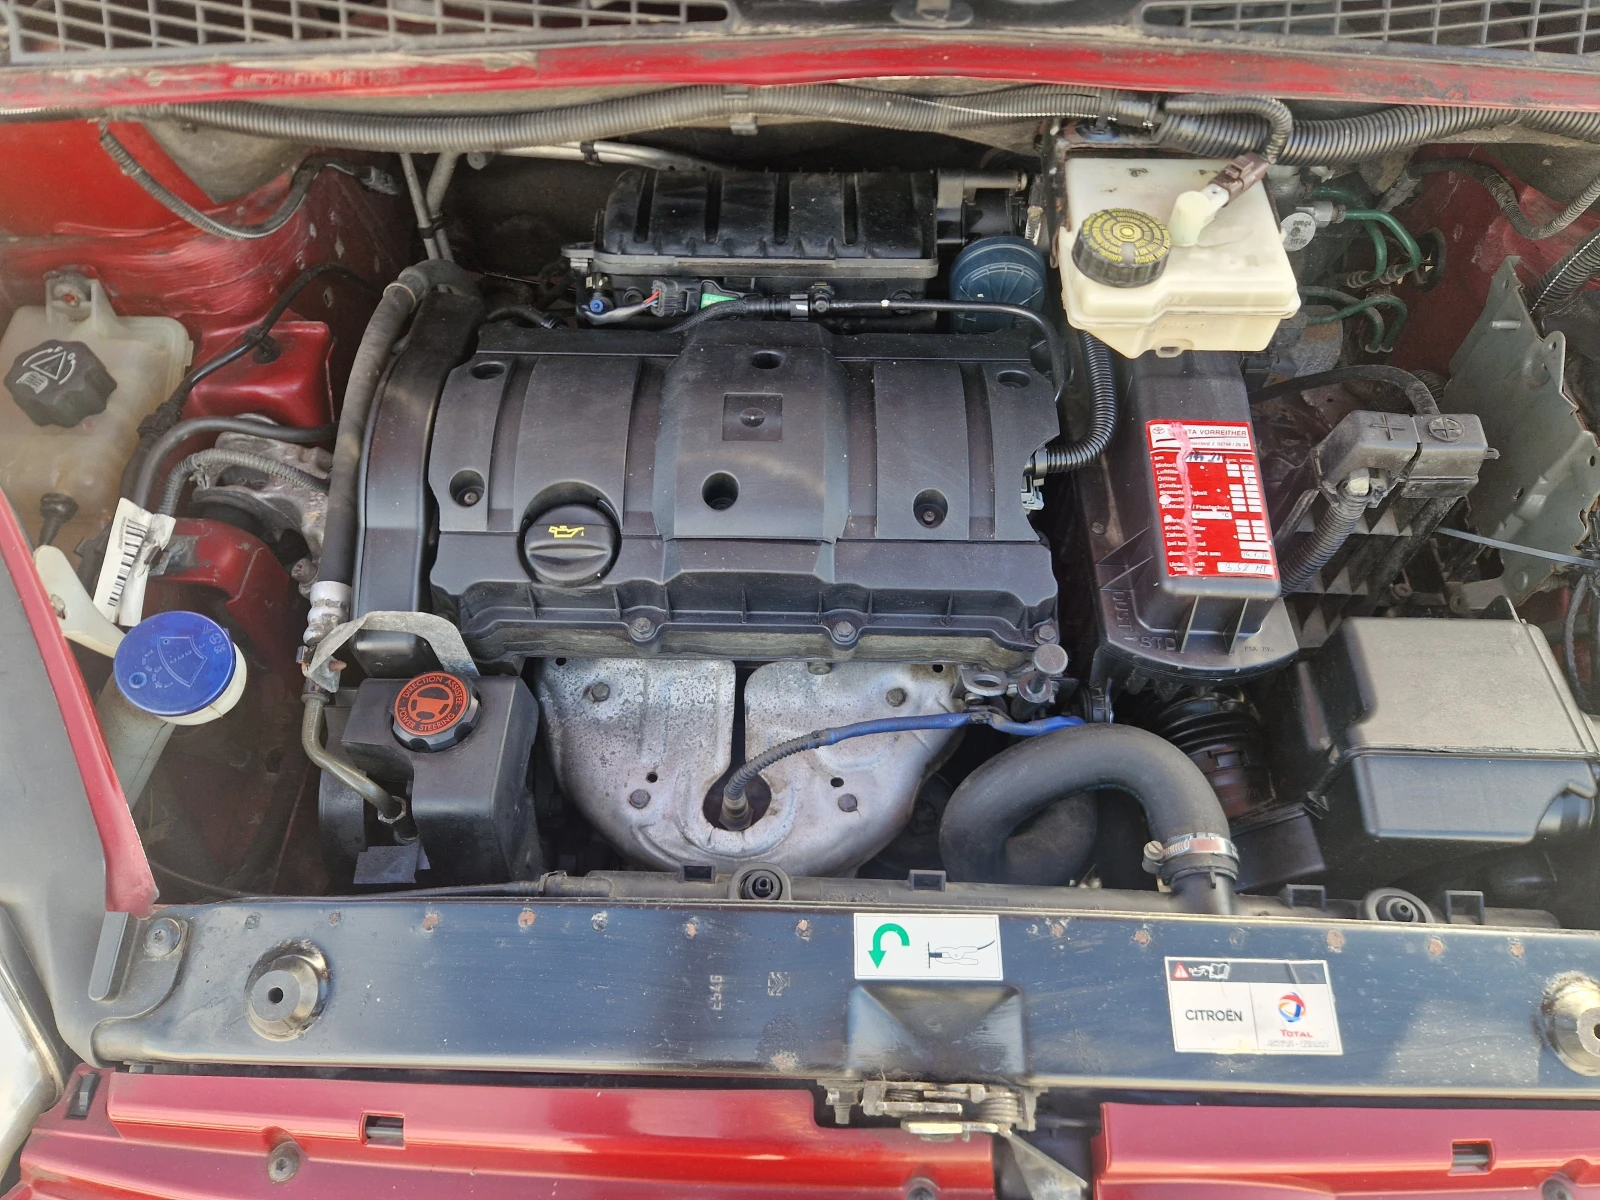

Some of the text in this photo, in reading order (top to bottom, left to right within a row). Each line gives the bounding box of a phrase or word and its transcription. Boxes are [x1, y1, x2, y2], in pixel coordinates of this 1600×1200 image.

[403, 675, 443, 699] DIRECTION
[398, 707, 456, 732] POWER STEERING
[1185, 1009, 1243, 1022] CITROËN
[1280, 1028, 1314, 1038] TOTAL
